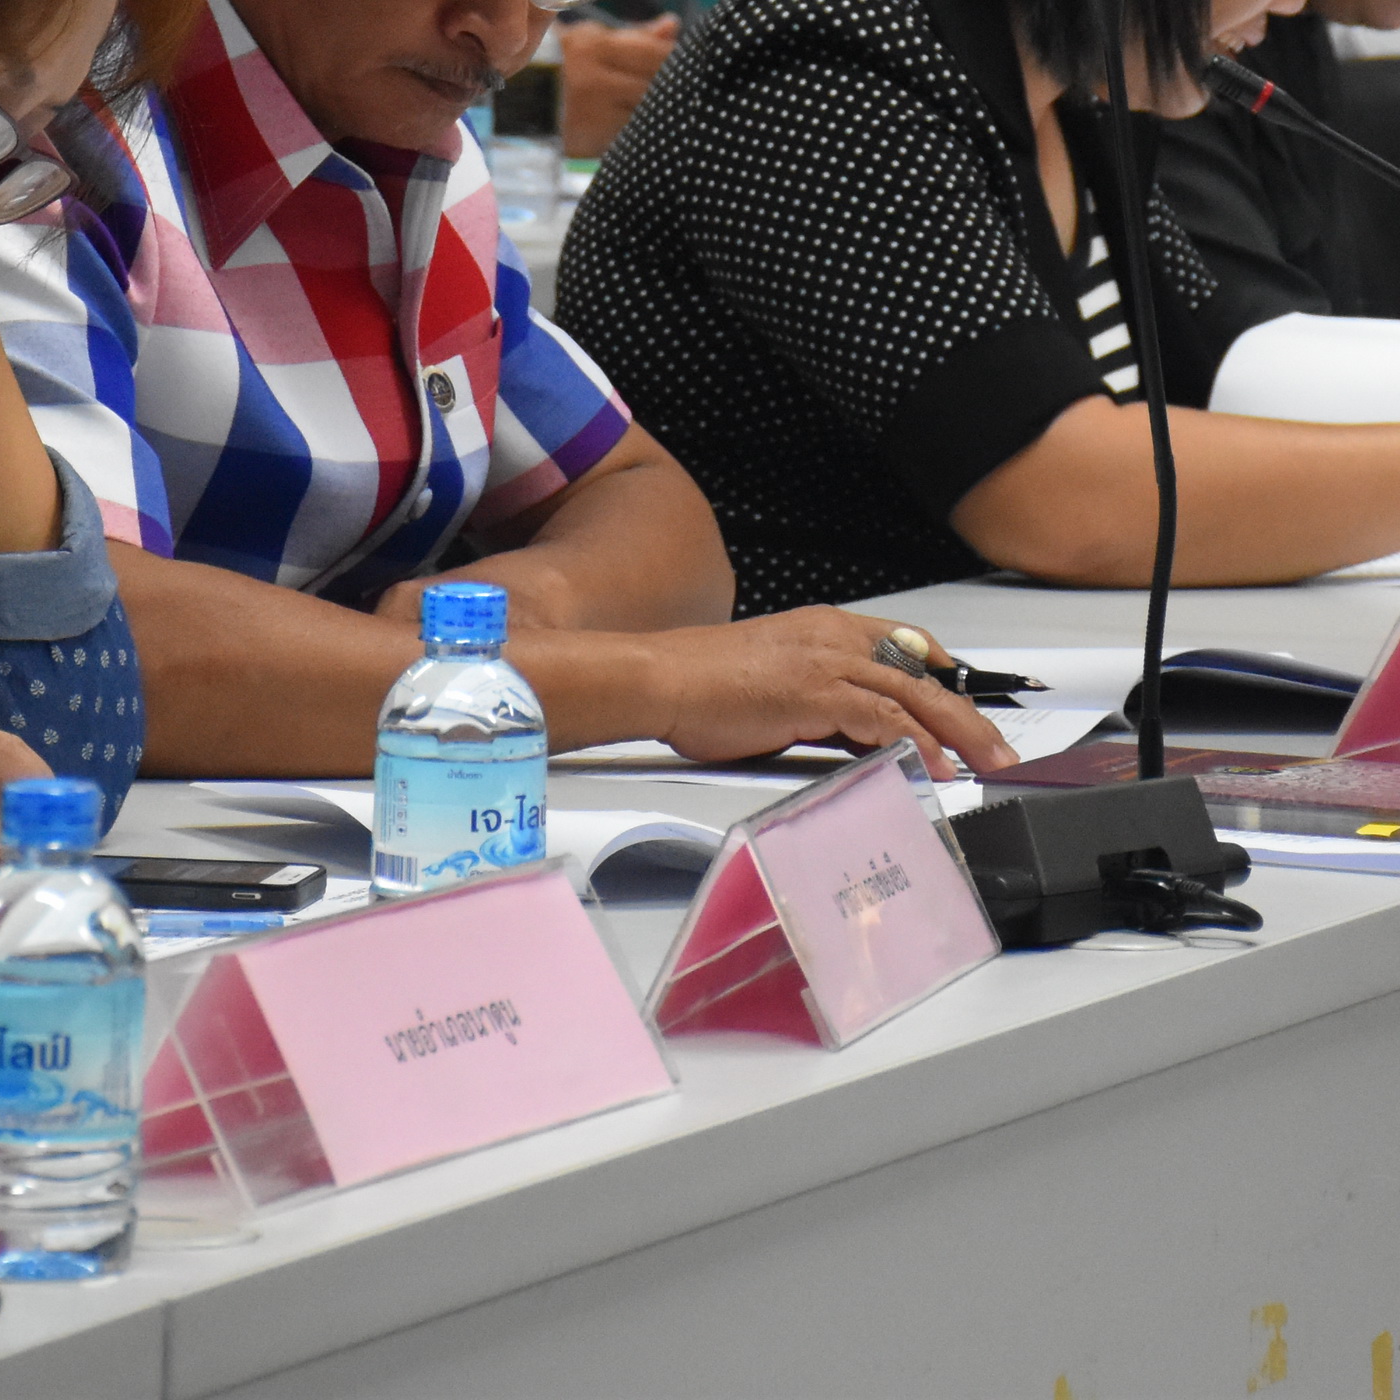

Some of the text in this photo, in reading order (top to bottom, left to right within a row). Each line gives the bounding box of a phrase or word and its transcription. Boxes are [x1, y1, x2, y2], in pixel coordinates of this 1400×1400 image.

[385, 999, 521, 1062] นายอำเภอนาดูน
